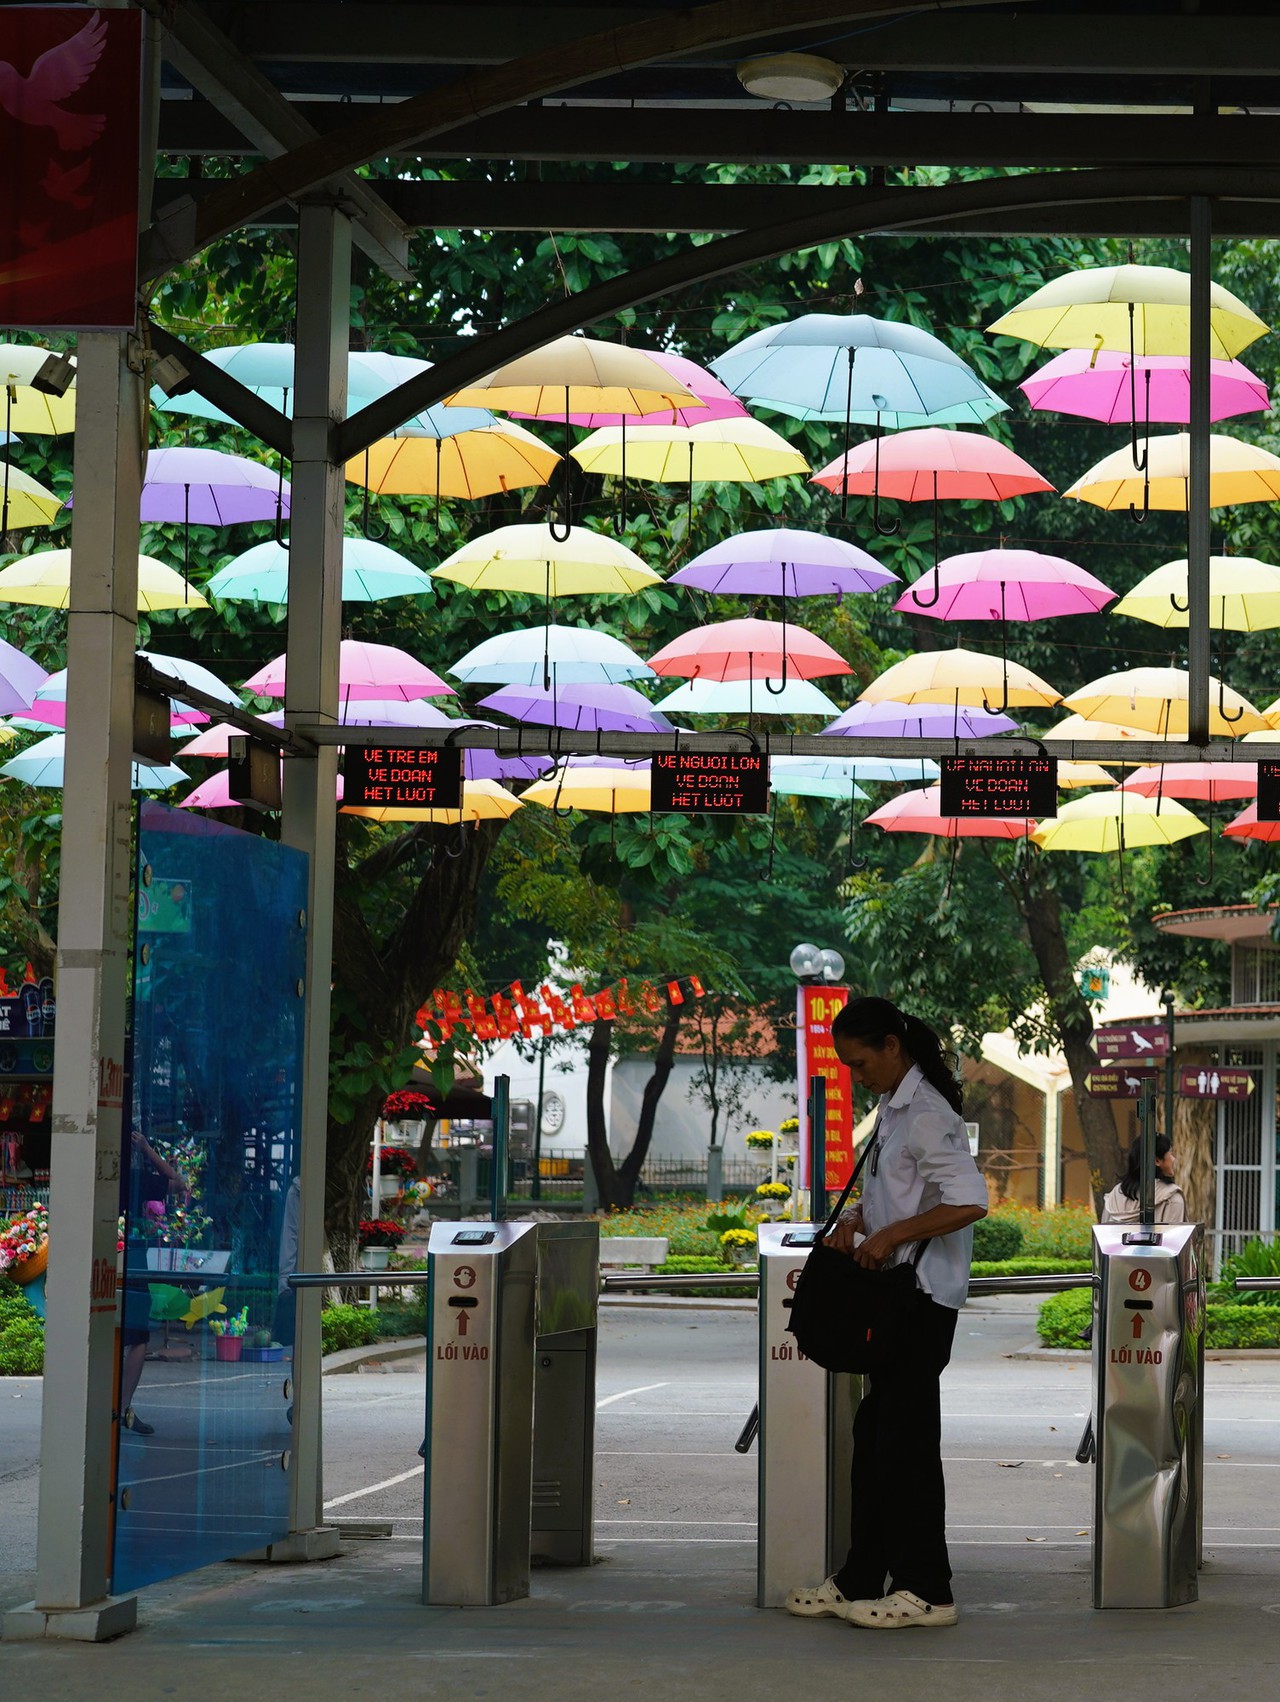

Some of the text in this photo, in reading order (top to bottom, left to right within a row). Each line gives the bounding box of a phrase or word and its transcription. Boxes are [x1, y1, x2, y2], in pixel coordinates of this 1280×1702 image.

[364, 749, 438, 764] VE TRE EM
[658, 755, 760, 770] VE NGUOI LON
[368, 768, 432, 783] VE DOAN
[364, 787, 436, 801] HET LUOT
[437, 1340, 489, 1361] LỐI VÀO
[771, 1341, 792, 1361] LỐI
[1111, 1344, 1163, 1364] LỐI VÀO
